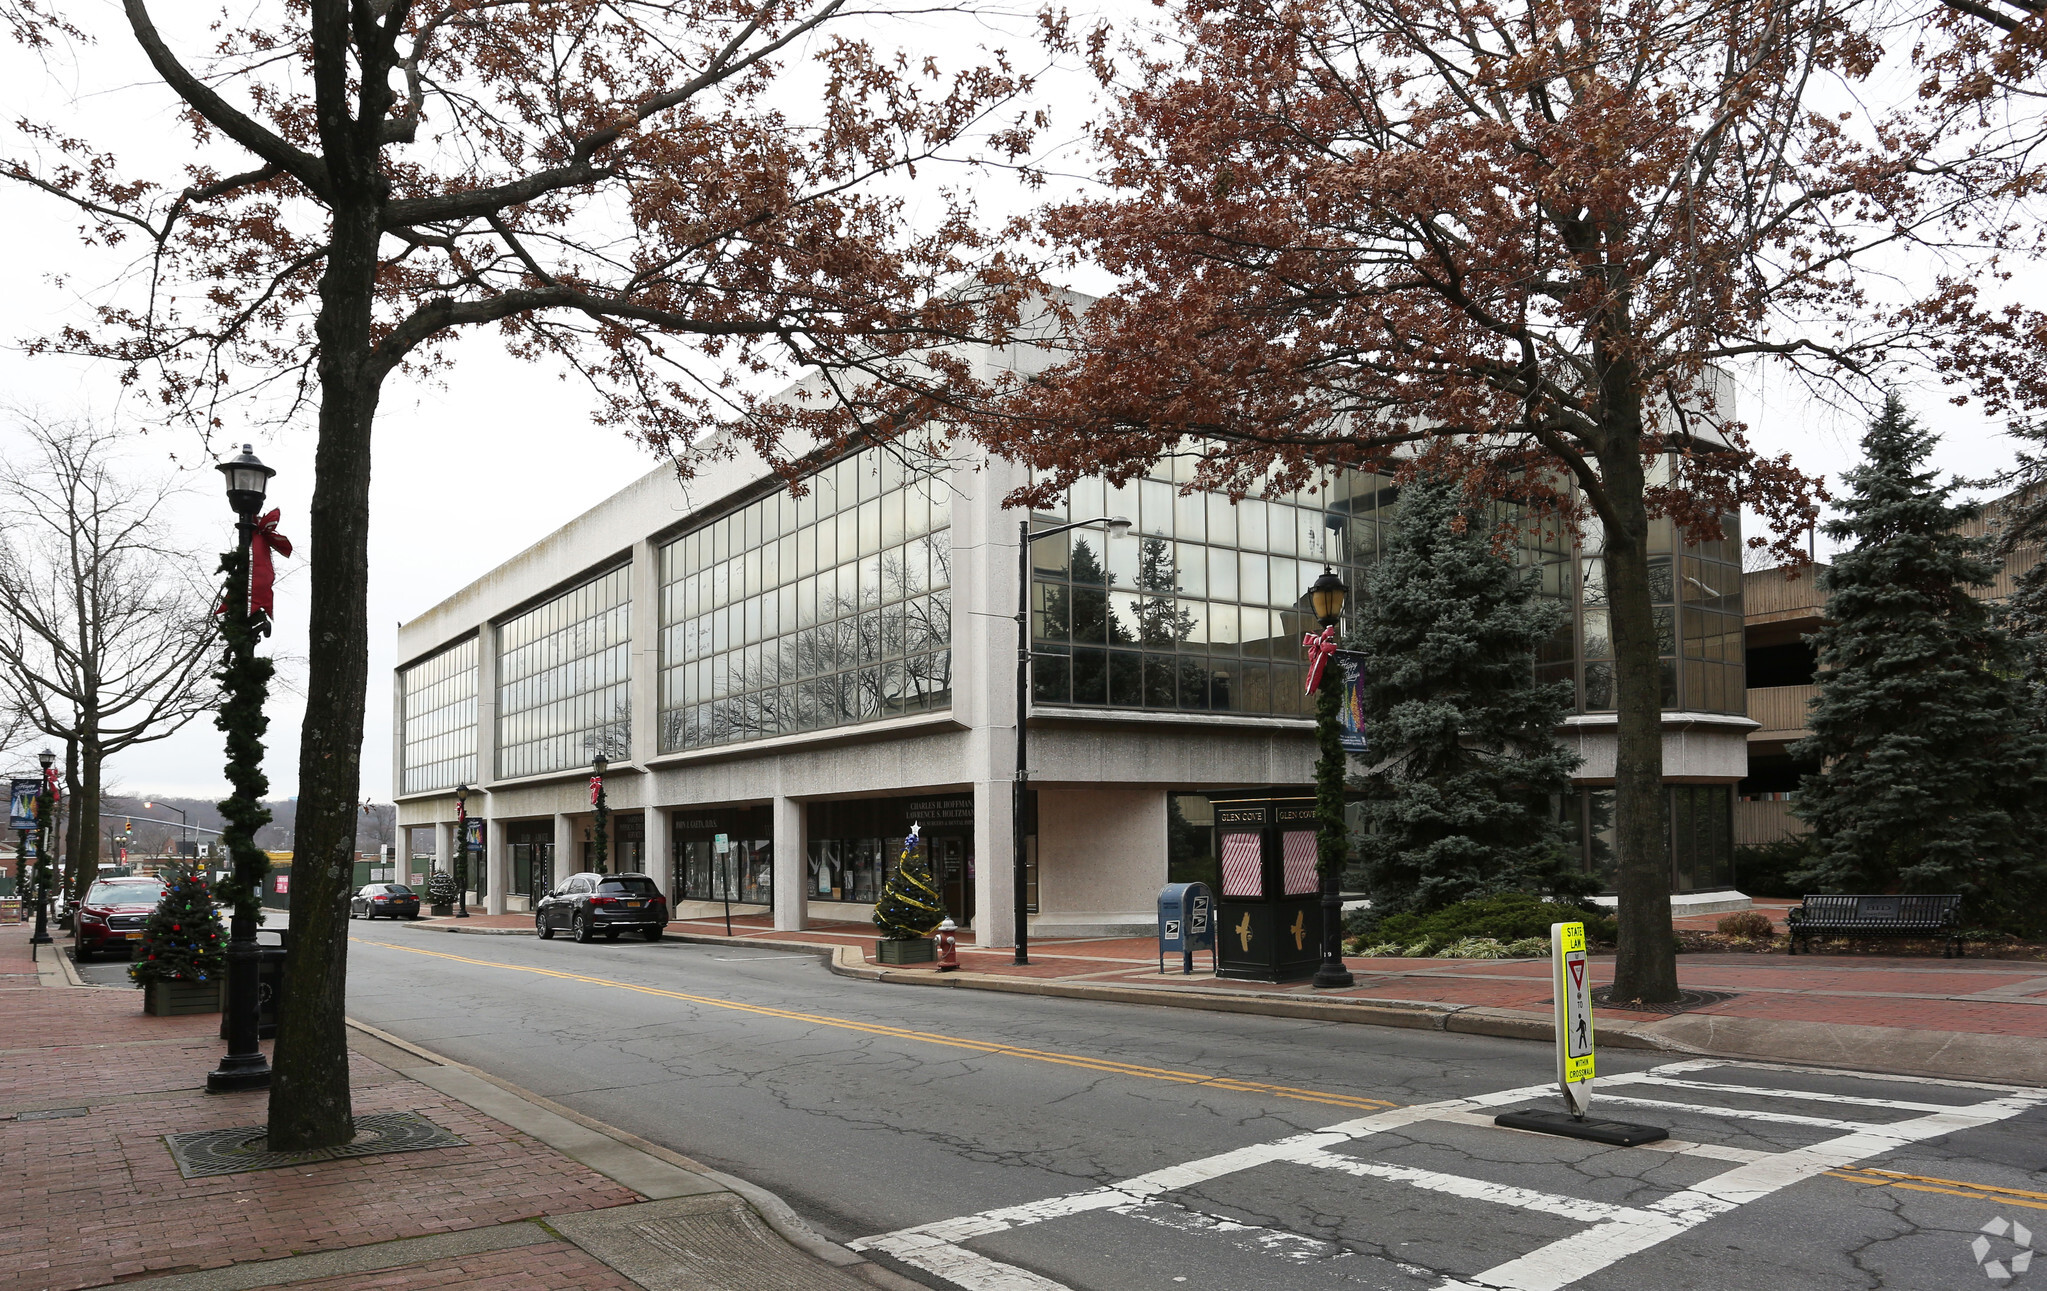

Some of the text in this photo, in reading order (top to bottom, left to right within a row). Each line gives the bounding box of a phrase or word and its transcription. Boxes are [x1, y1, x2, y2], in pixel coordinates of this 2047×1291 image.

[910, 802, 936, 810] CHARLES
[906, 811, 936, 819] LAWRENCE
[1221, 812, 1262, 822] GLEN COVE
[1279, 811, 1297, 820] GLEN
[1567, 926, 1582, 937] STATE
[1571, 939, 1582, 949] LAW
[1577, 1001, 1583, 1009] TO
